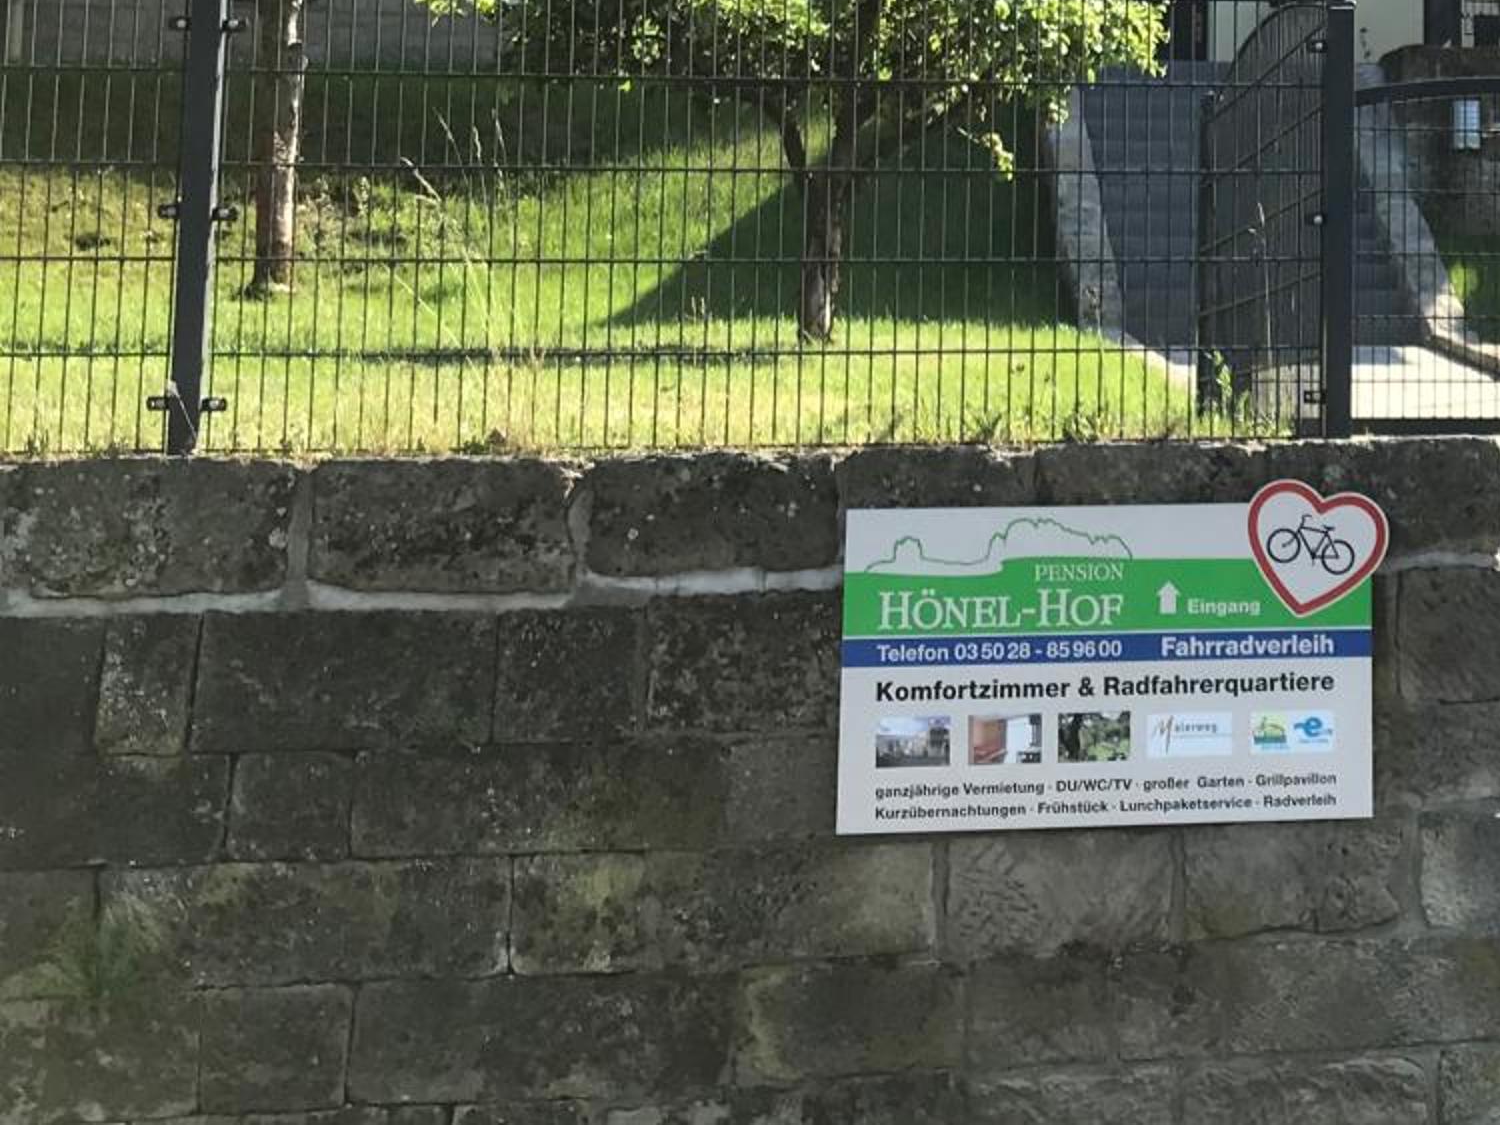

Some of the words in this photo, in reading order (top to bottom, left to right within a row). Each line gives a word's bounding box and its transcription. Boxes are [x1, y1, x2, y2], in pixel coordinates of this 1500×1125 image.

[1034, 562, 1125, 582] PENSION
[1186, 598, 1261, 617] Eingang
[877, 644, 949, 662] Telefon
[1160, 634, 1335, 657] Fahrradverleih
[876, 679, 1072, 702] Komfortzimmer
[1077, 676, 1095, 698] &
[1103, 672, 1335, 697] Radfahrerquartiere
[875, 783, 959, 800] ganzjährige
[962, 780, 1045, 797] Vermietung
[1055, 778, 1132, 792] DU/WC/TV
[1197, 775, 1245, 789] Garten
[1255, 773, 1337, 788] Grillpavillon
[875, 804, 1027, 820] Kurzübernachtungen
[1037, 801, 1109, 815] Frühstück
[1119, 796, 1253, 813] Lunchpaketservice
[1263, 793, 1337, 808] Radverleih
